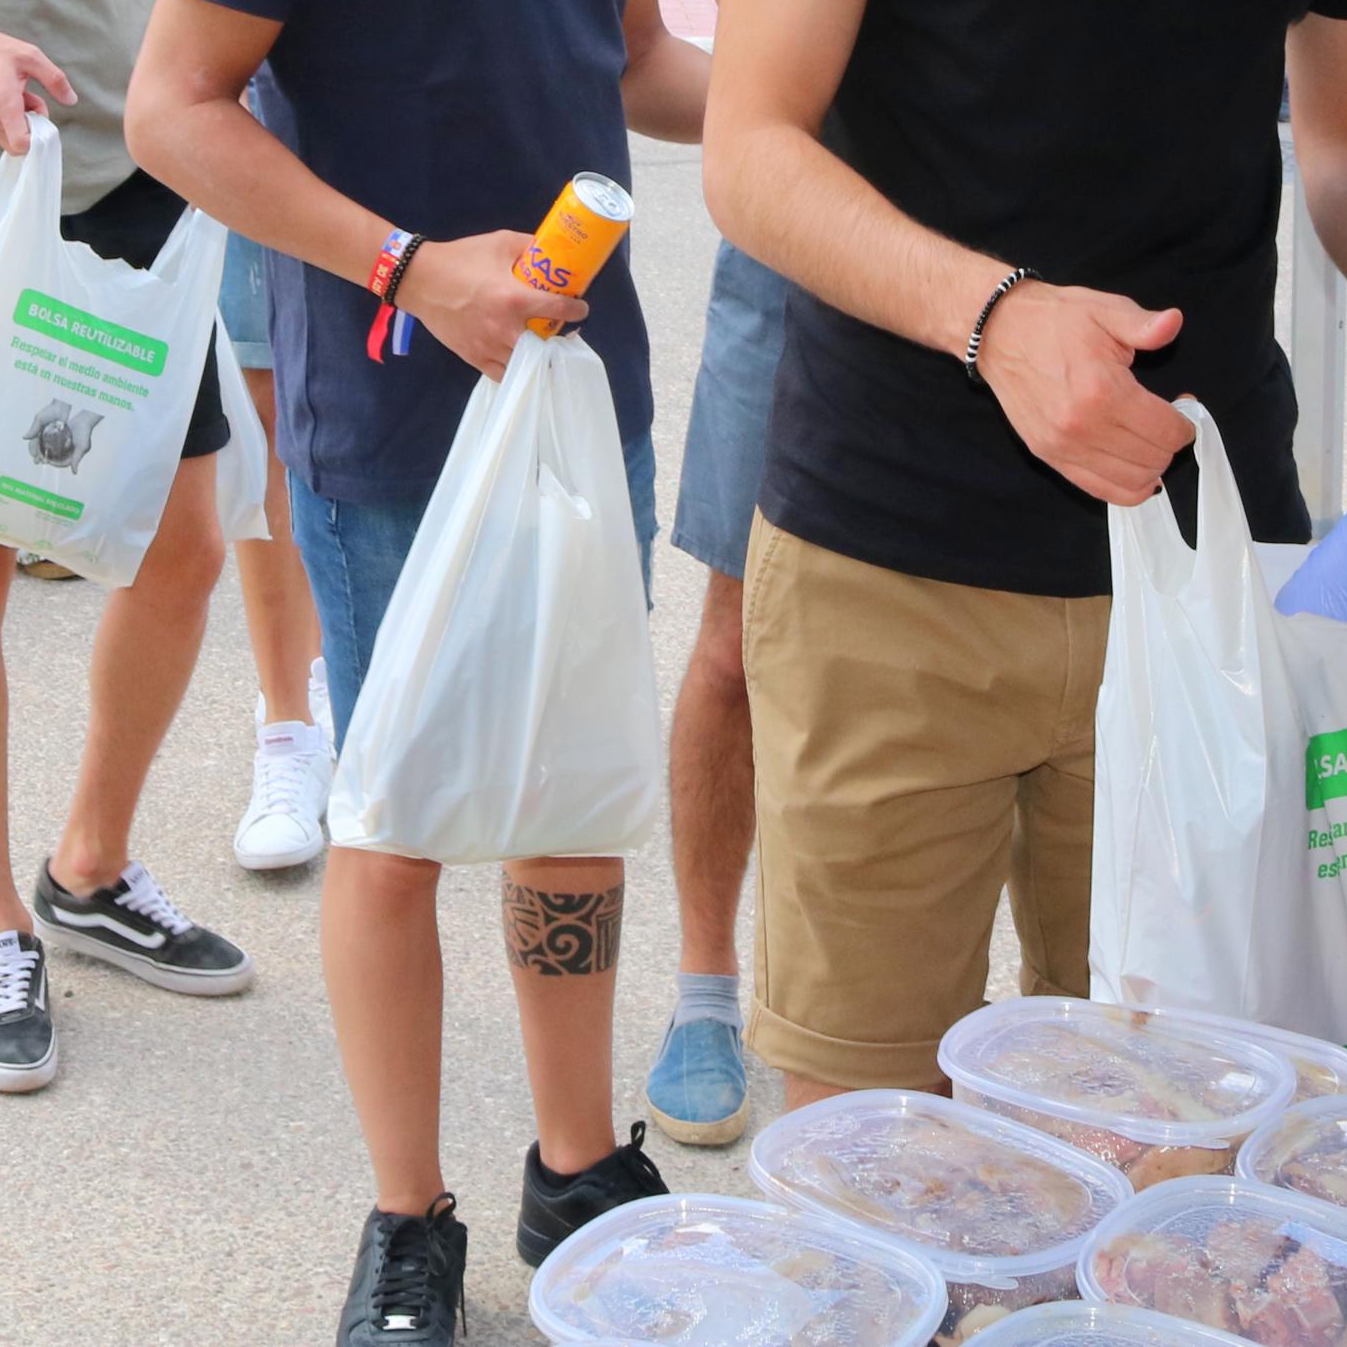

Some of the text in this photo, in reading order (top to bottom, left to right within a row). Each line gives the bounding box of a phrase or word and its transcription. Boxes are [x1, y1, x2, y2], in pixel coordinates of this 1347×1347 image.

[28, 303, 156, 363] BOLSA REUTILIZABLE
[68, 360, 100, 379] medio
[102, 371, 149, 397] ambiente
